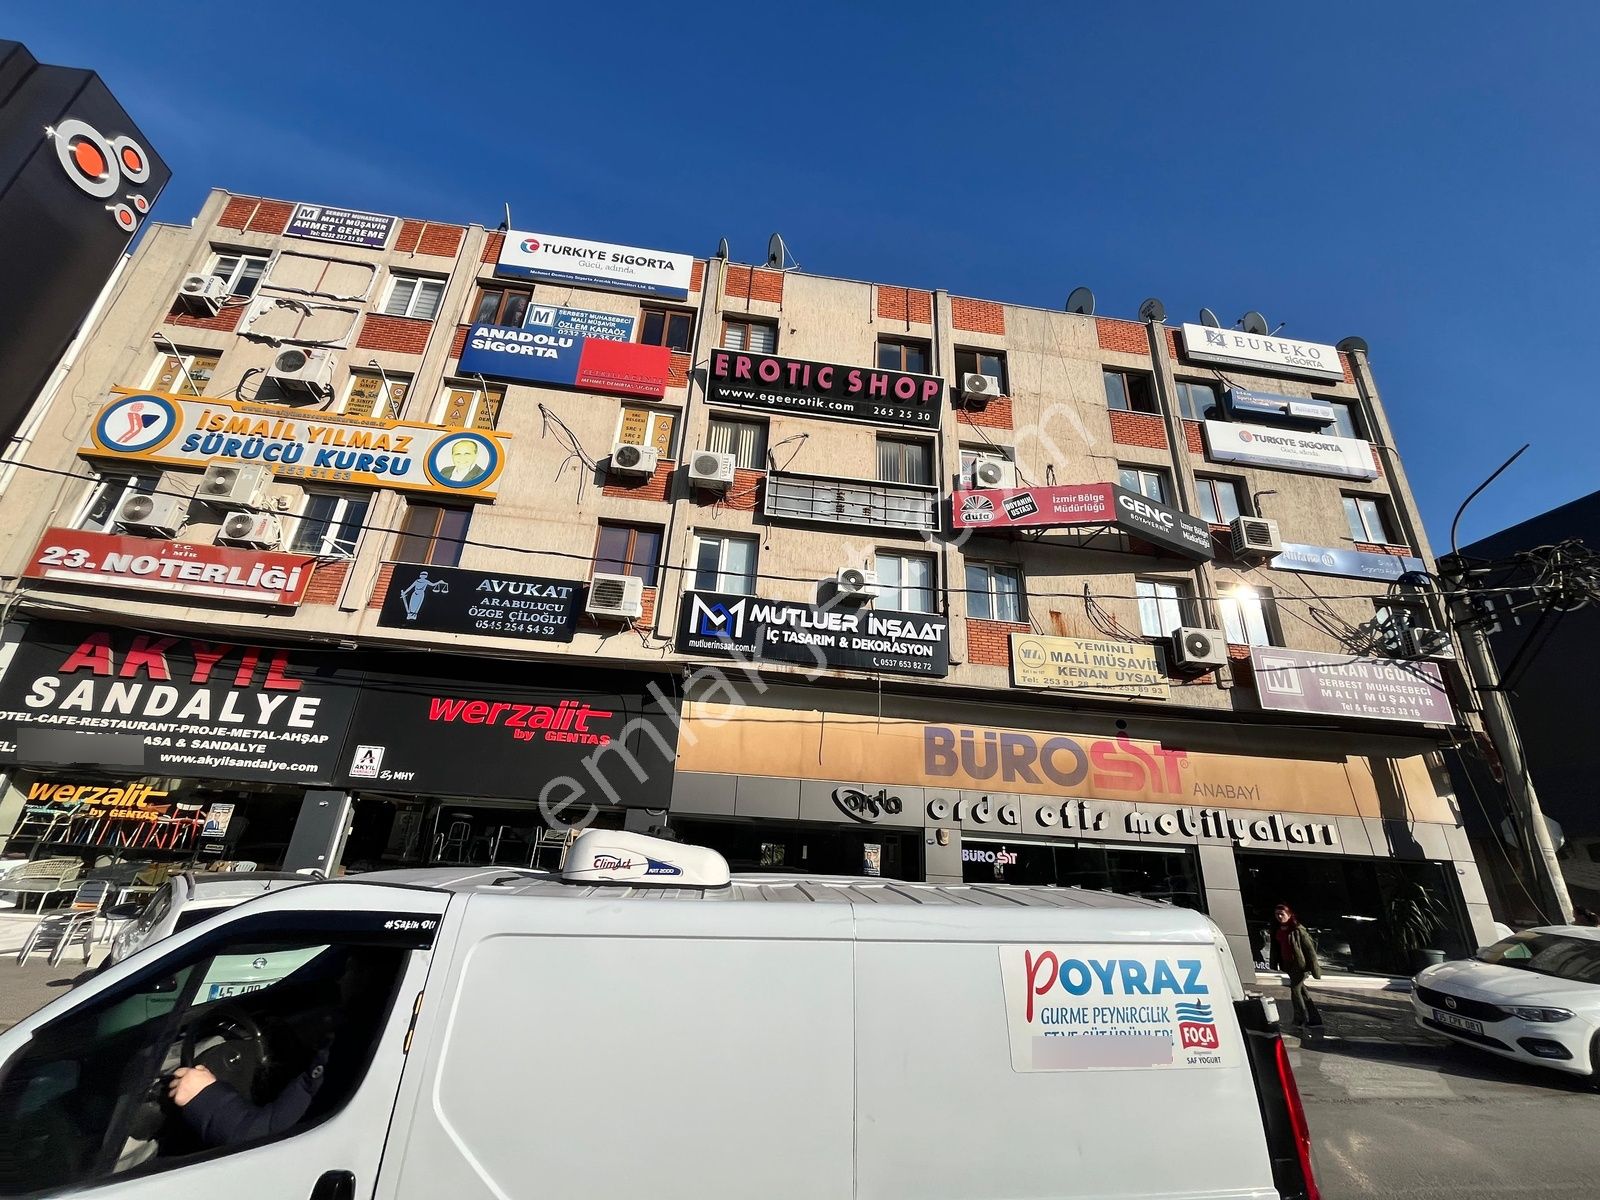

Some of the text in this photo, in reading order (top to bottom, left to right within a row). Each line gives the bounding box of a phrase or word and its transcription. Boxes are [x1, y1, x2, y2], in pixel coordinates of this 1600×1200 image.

[293, 220, 385, 240] AHMET GEREME
[320, 216, 387, 230] MALİ MÜŞAVİR
[558, 310, 631, 324] SERBEST MUHASEBECİ
[474, 327, 574, 348] ANADOLU
[558, 321, 626, 336] ÖZLEM KARAÖZ
[472, 338, 558, 360] SİGORTA
[1234, 336, 1320, 360] EUREKO
[714, 353, 939, 401] EROTIC SHOP
[718, 388, 931, 421] www.egeerotik.com 265 25 30
[196, 409, 414, 453] İSMAİL YILMAZ
[181, 433, 412, 476] SÜRÜCÜ KURSU
[1053, 493, 1104, 504] İzmir Bölge
[1054, 502, 1106, 513] Müdürlüğü
[1010, 504, 1032, 516] USTASI
[1119, 495, 1174, 528] GENÇ
[38, 546, 302, 592] 23. NOTERLİĞİ
[476, 578, 572, 600] AVUKAT
[480, 596, 564, 613] ARABULUCU
[468, 606, 566, 626] ÖZGE ÇİLOĞLU
[750, 603, 946, 642] MUTLUER İNŞAAT
[476, 620, 555, 635] 0545 254 54 52
[688, 638, 757, 652] mutluerinsaat.com.tr
[766, 626, 933, 657] İÇ TASARIM & DEKORASYON
[1074, 642, 1134, 654] YEMİNLİ
[58, 632, 304, 690] AKYIL
[880, 658, 932, 671] 0537 653 82 72
[1050, 652, 1089, 664] MALİ
[1058, 666, 1108, 680] KENAN
[1306, 660, 1369, 678] VOLKAN
[1021, 676, 1038, 684] Tel:
[1320, 678, 1432, 696] SERBEST MUHASEBECİ
[24, 676, 322, 728] SANDALYE
[1321, 688, 1434, 707] MALİ MÜŞAVİR
[428, 698, 612, 732] werzalit
[1341, 702, 1353, 712] Tel
[1381, 706, 1396, 715] 253
[1398, 708, 1408, 716] 33
[514, 728, 535, 741] by
[143, 736, 267, 754] ASA & SANDALYE
[160, 752, 318, 773] www.akyilsandalye.com
[380, 770, 392, 780] By
[393, 772, 415, 780] MHY
[28, 782, 168, 808] werzalit
[1193, 782, 1260, 800] ANABAYİ
[89, 808, 106, 818] by
[929, 795, 1338, 848] orda ofis mobilyaları
[1024, 950, 1209, 1024] POYRAZ
[1041, 1006, 1170, 1025] GURME PEYNİRCİLİK
